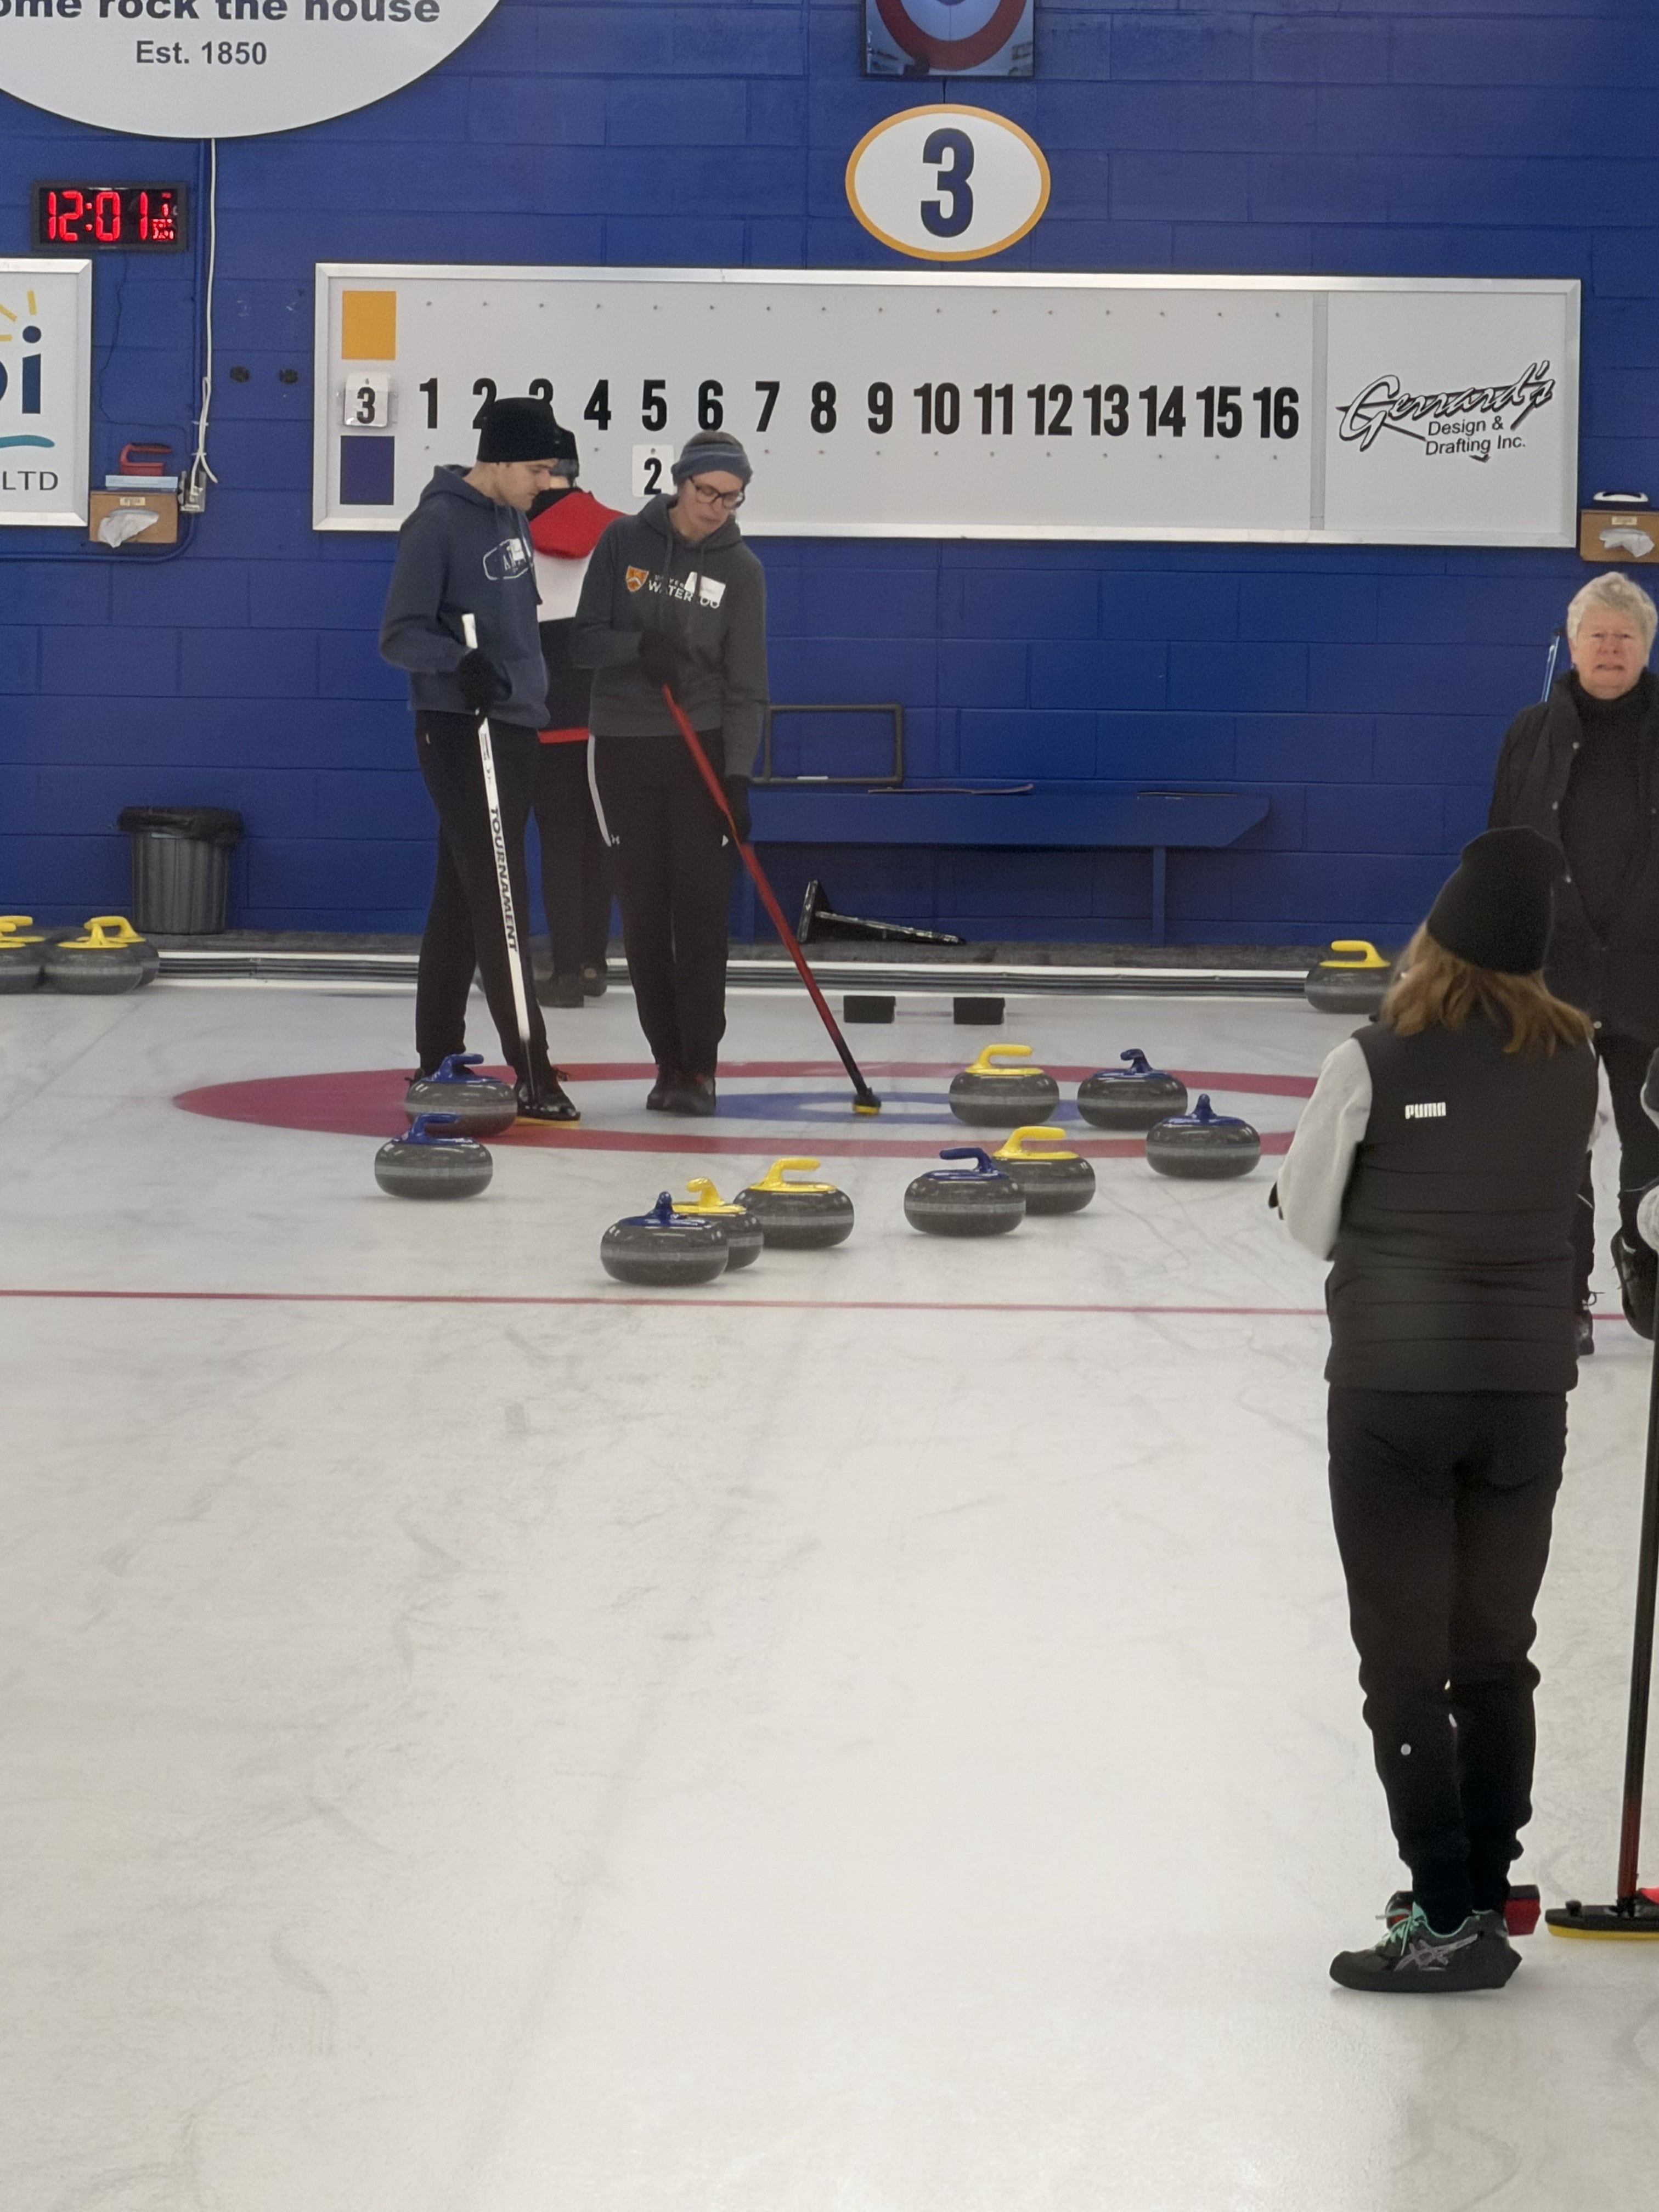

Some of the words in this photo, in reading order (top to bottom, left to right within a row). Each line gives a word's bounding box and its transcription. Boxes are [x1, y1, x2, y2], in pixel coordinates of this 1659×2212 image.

[99, 0, 199, 19] rock
[216, 0, 287, 20] the
[305, 0, 440, 22] house
[137, 40, 189, 64] Est.
[201, 41, 267, 65] 1850
[920, 127, 975, 239] 3
[357, 386, 376, 424] 3
[420, 377, 438, 429] 1
[472, 377, 497, 430] 2
[584, 379, 611, 431] 4
[642, 380, 667, 432] 5
[698, 380, 723, 432] 6
[755, 381, 780, 432] 7
[811, 381, 837, 433] 8
[868, 382, 893, 434] 9
[914, 382, 960, 435] 10
[974, 383, 1013, 435] 11
[1027, 384, 1073, 436] 12
[1083, 385, 1129, 437] 13
[1139, 385, 1186, 437] 14
[1196, 386, 1242, 438] 15
[1253, 387, 1299, 439] 16
[1338, 360, 1556, 452] Gerrard's
[1428, 419, 1486, 436] Design
[1492, 416, 1504, 431] &
[1425, 437, 1491, 456] Drafting
[1497, 435, 1526, 449] Inc.
[3, 471, 59, 491] LTD
[644, 457, 662, 495] 2
[491, 807, 518, 952] TOURNAMENT
